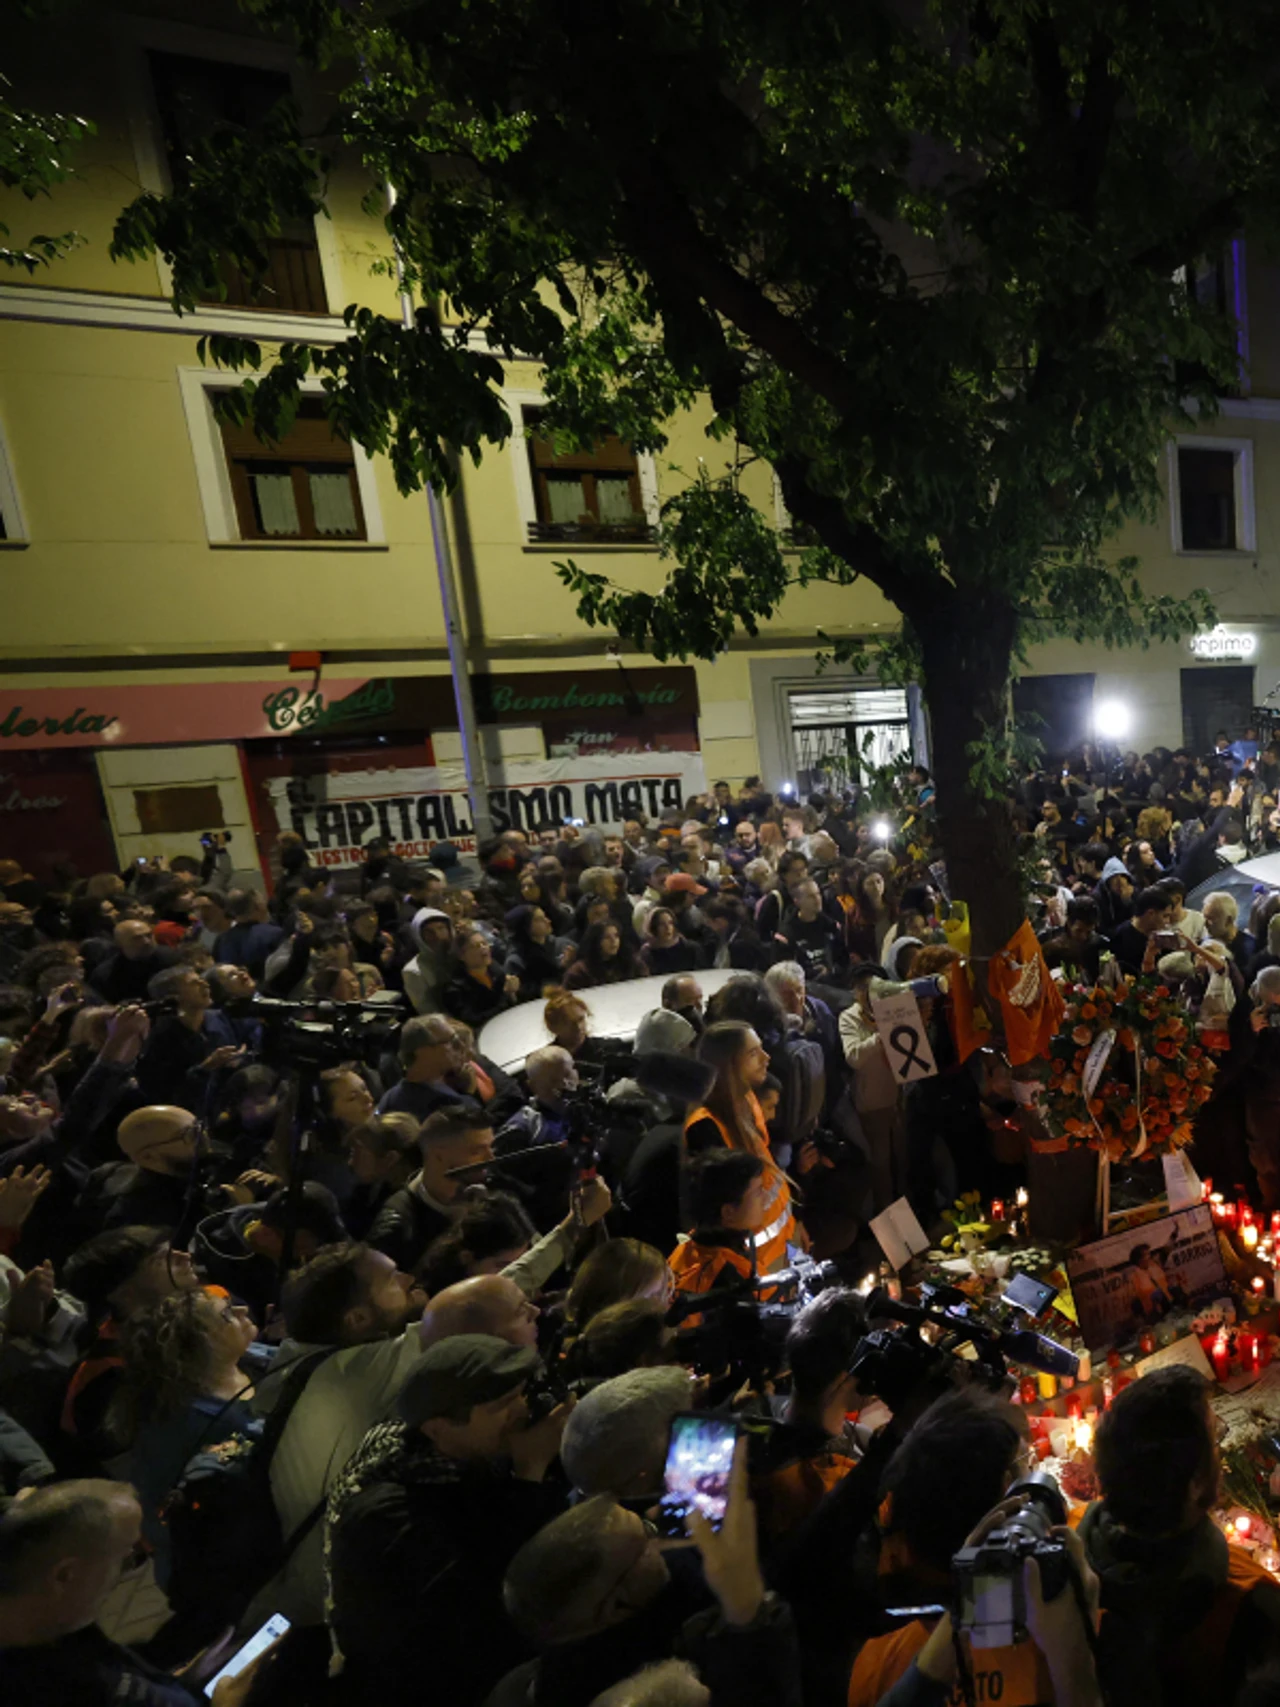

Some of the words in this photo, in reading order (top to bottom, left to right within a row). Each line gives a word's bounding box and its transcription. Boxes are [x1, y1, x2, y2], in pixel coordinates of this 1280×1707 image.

[490, 683, 683, 713] Bombonría
[0, 706, 118, 737] lería
[585, 778, 684, 825] MATA
